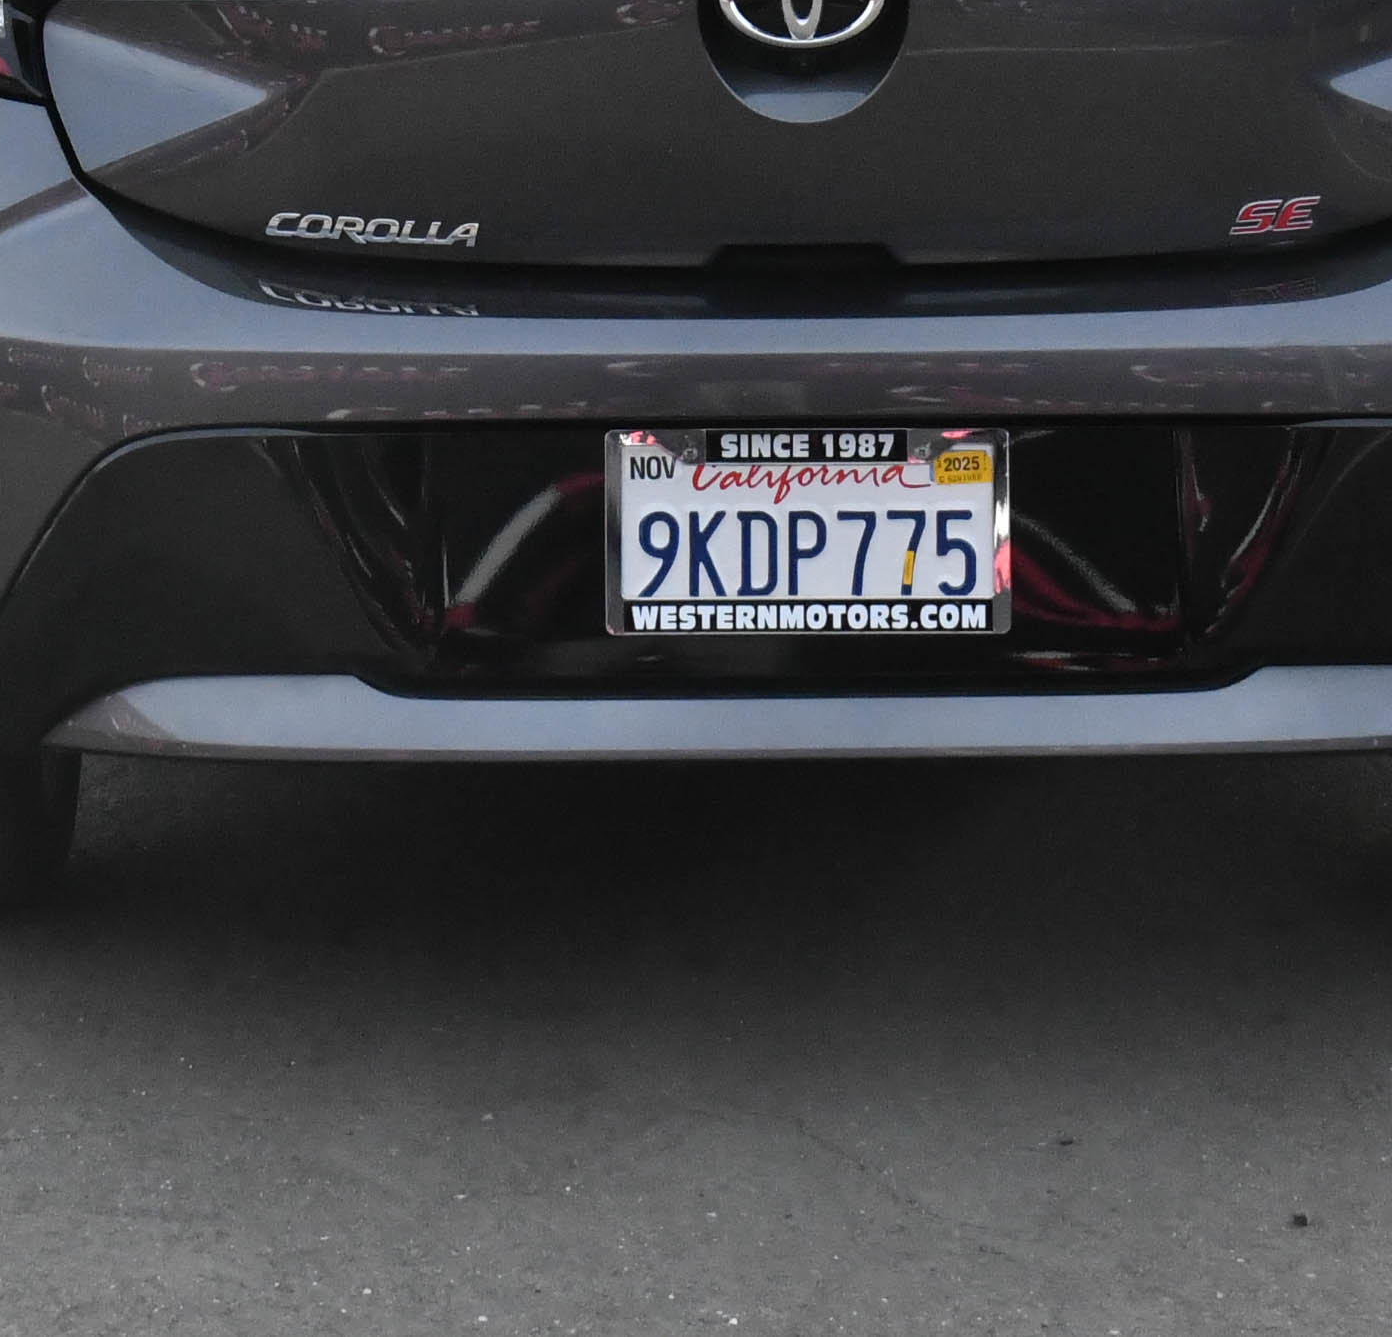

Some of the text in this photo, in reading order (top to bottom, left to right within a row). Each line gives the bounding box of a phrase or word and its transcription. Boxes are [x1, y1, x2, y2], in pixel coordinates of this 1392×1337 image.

[265, 212, 480, 247] COROLLA
[1229, 195, 1321, 235] SE
[720, 433, 895, 458] SINCE 1987
[629, 455, 676, 480] NOV
[944, 456, 980, 472] 2025
[692, 464, 932, 504] California
[638, 510, 977, 597] 9KDP775
[631, 604, 987, 631] WESTERNMOTORS.COM
